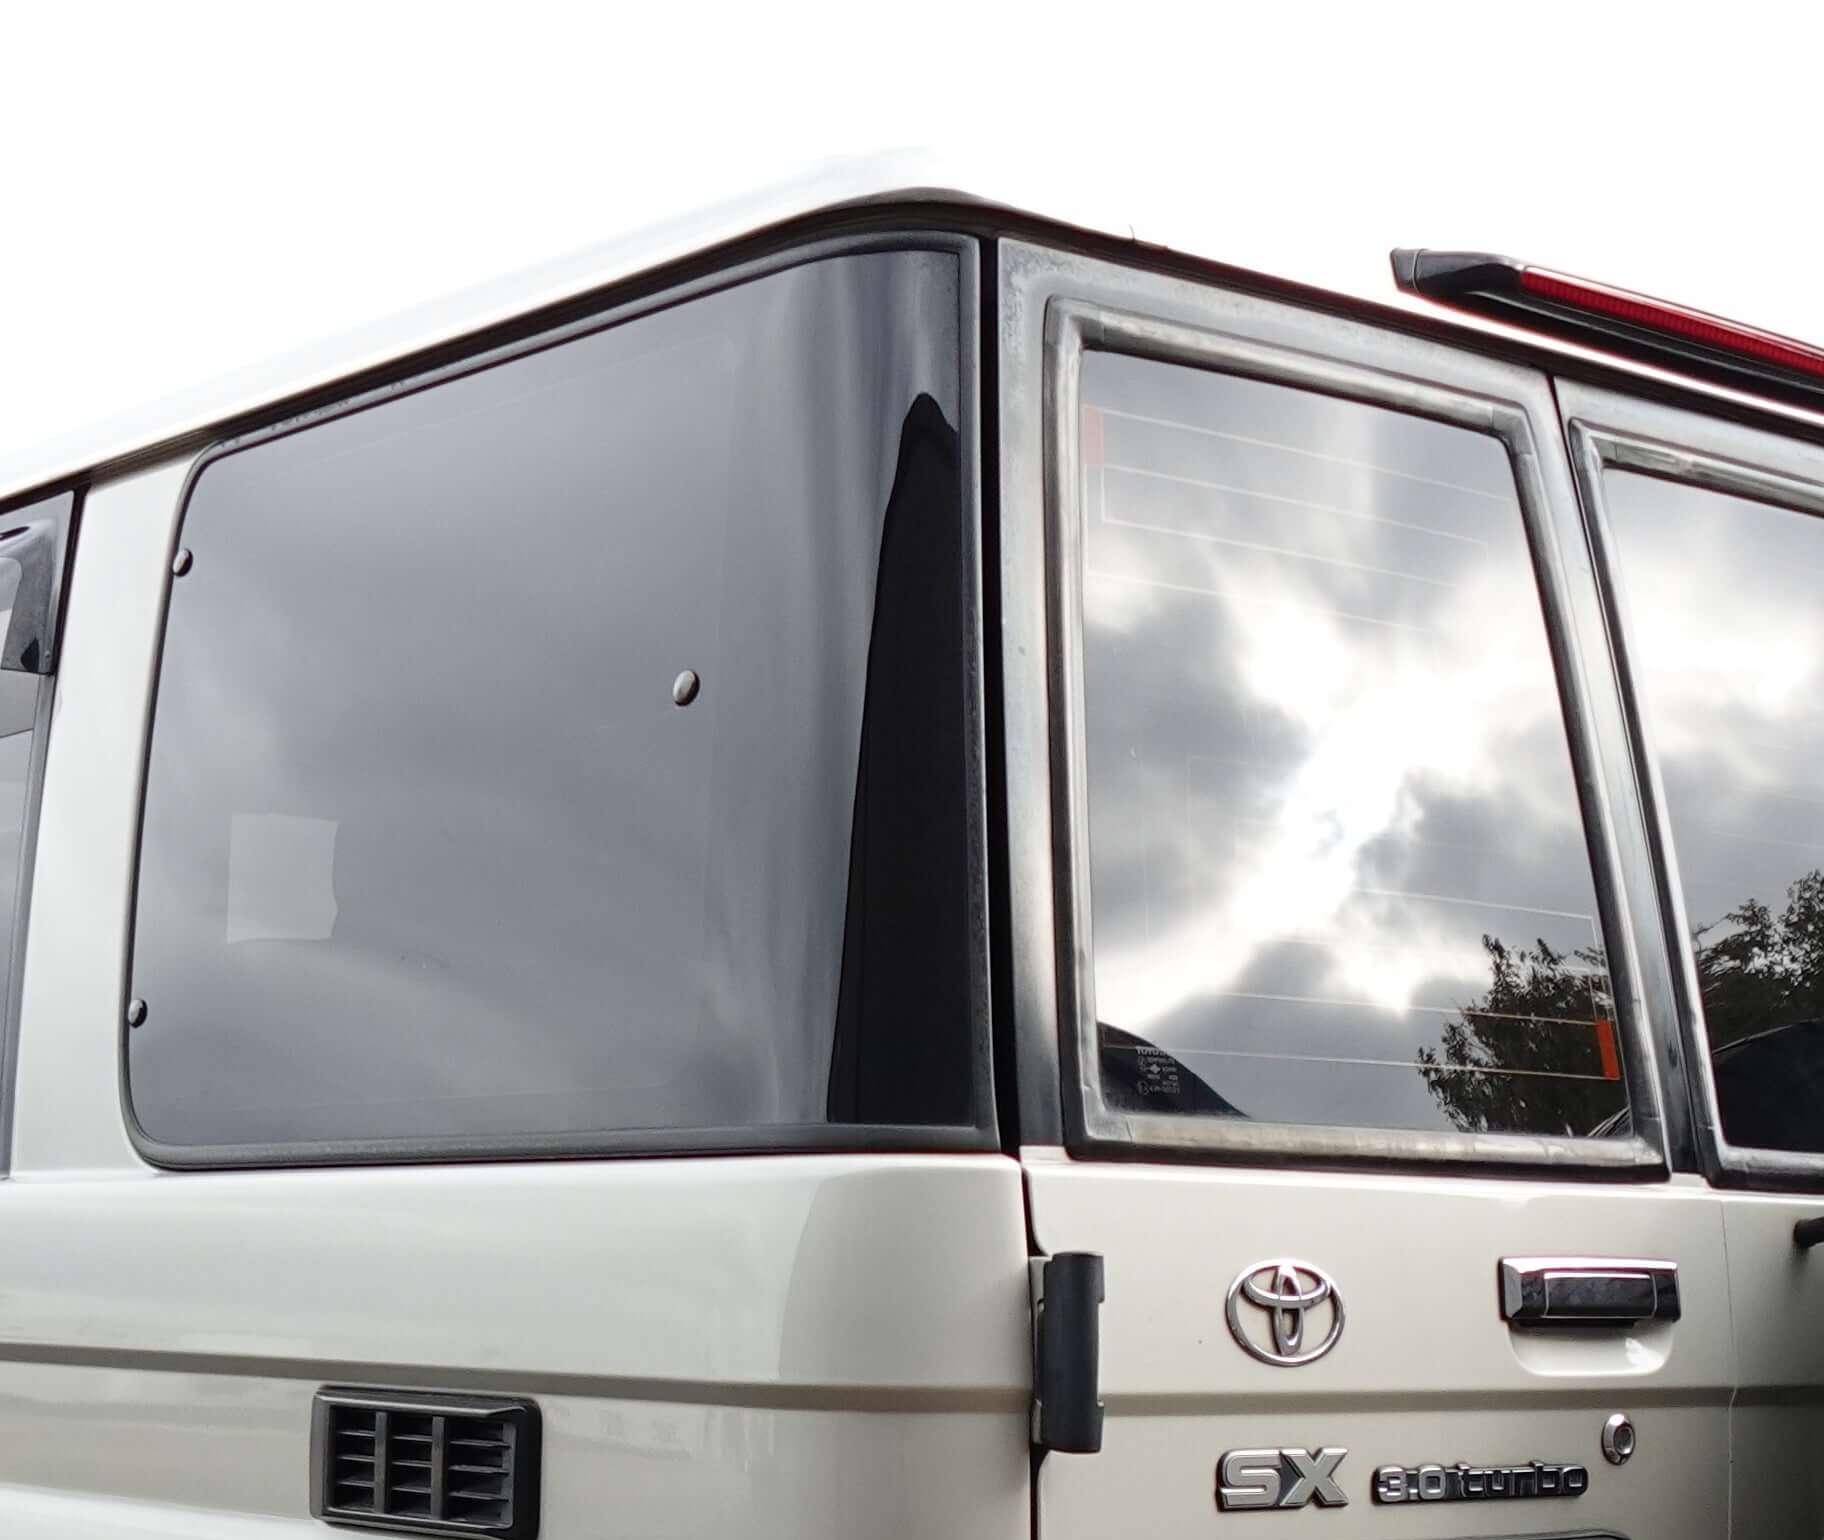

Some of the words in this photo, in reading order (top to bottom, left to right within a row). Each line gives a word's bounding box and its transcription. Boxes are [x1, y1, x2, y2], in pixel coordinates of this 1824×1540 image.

[1217, 1447, 1350, 1511] SX
[1373, 1464, 1447, 1503] 3.0
[1454, 1460, 1588, 1499] turbo
